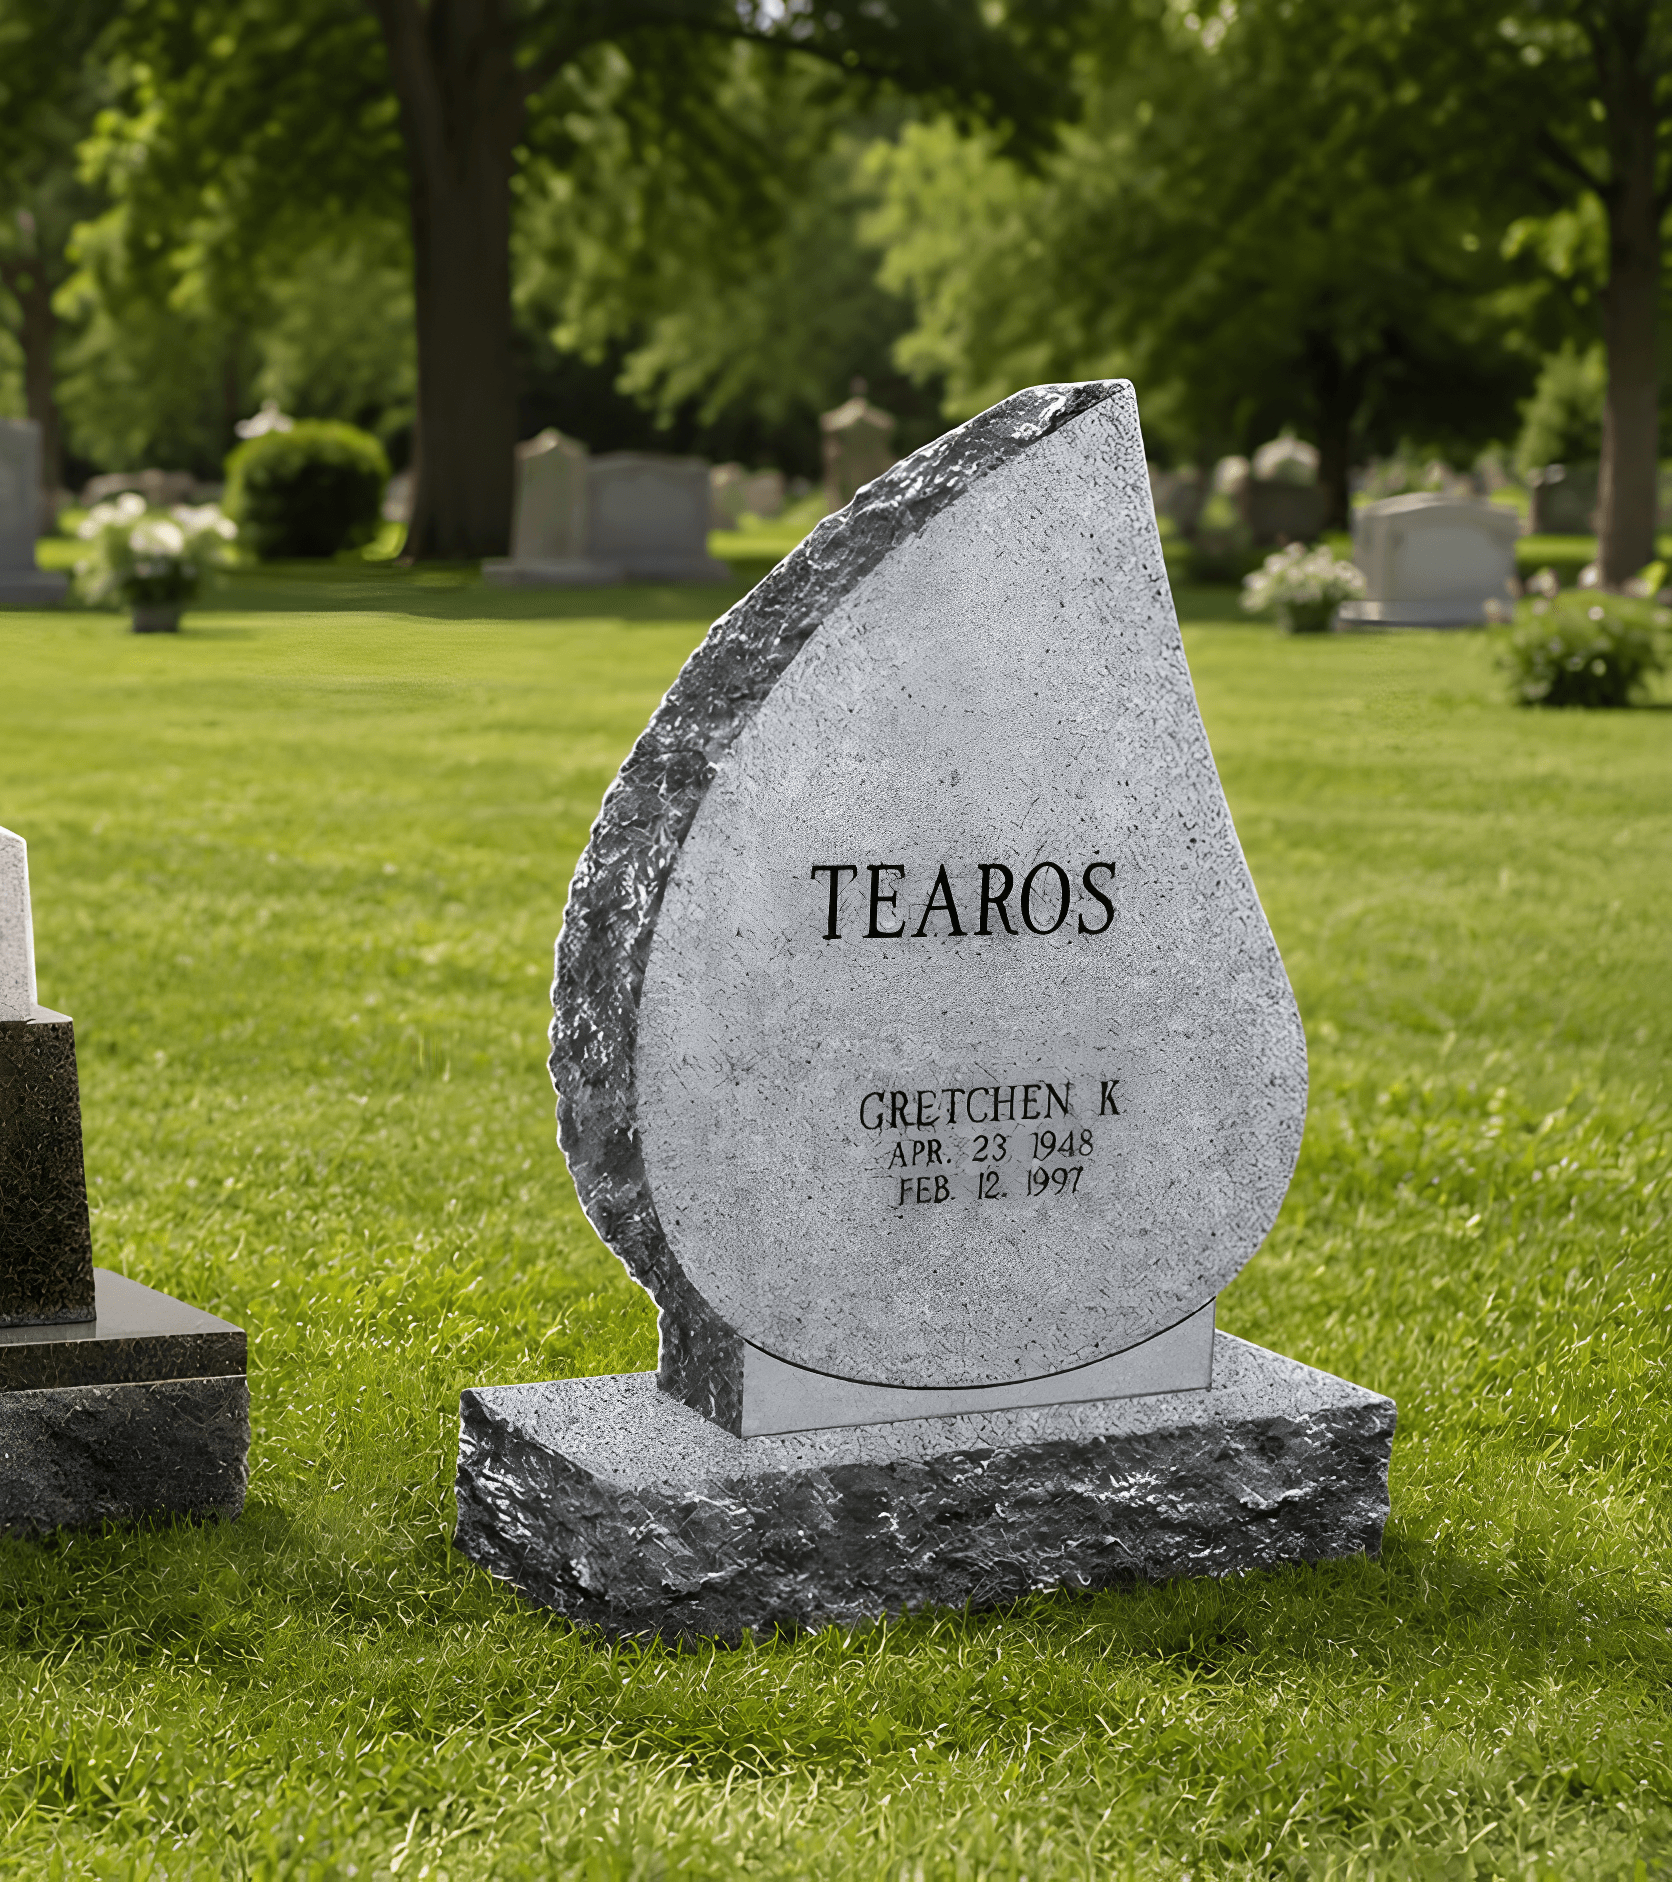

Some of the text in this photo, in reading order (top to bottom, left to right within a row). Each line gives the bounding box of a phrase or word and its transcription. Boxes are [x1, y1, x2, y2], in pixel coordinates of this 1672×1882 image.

[811, 861, 1116, 940] TEAROS
[859, 1079, 1120, 1131] GRETCHEN K
[888, 1129, 1094, 1169] APR. 23 1948
[897, 1174, 956, 1206] FEB.
[1027, 1165, 1085, 1197] 1997
